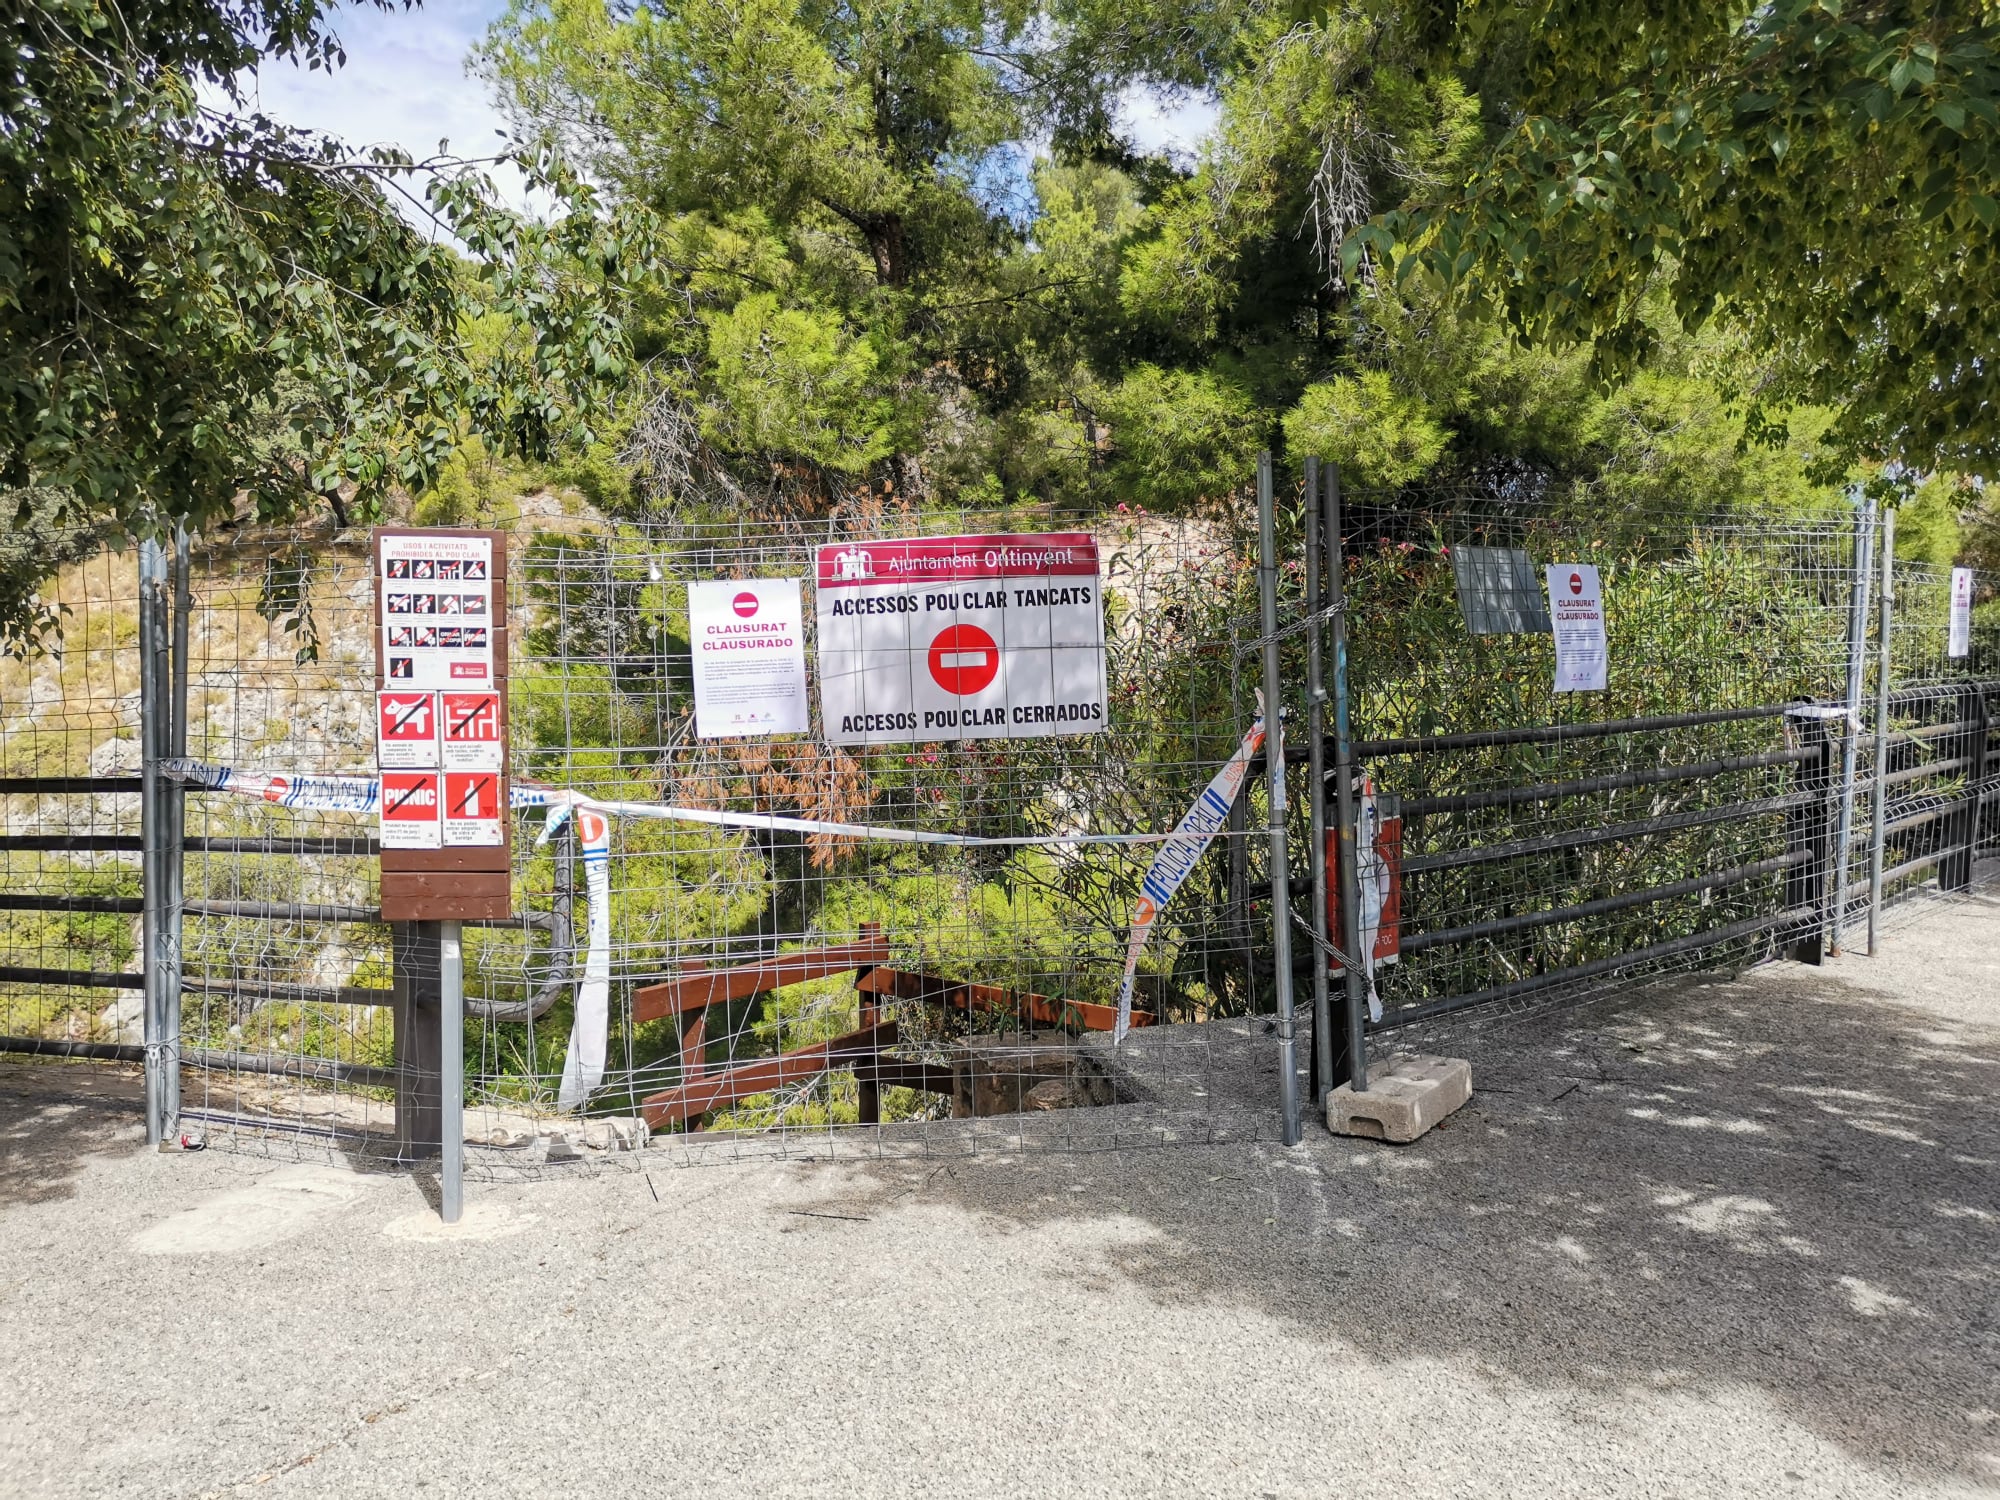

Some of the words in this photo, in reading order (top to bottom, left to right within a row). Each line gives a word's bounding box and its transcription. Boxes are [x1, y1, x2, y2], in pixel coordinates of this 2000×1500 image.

[889, 553, 978, 574] Ajuntament
[984, 548, 1074, 570] Ontinyent
[832, 595, 918, 616] ACCESSOS
[926, 593, 958, 611] POU
[964, 591, 1007, 609] CLAR
[1014, 587, 1091, 607] TANCATS
[1557, 612, 1599, 620] CLAUSURADO
[707, 622, 787, 634] CLAUSURAT
[702, 638, 793, 650] CLAUSURADO
[842, 712, 918, 732] ACCESOS
[924, 710, 958, 728] POU
[962, 708, 1006, 726] CLAR
[1012, 702, 1100, 722] CERRADOS
[384, 788, 436, 806] PICNIC
[1156, 838, 1198, 889] POLICIA
[1184, 806, 1222, 850] LOCAL
